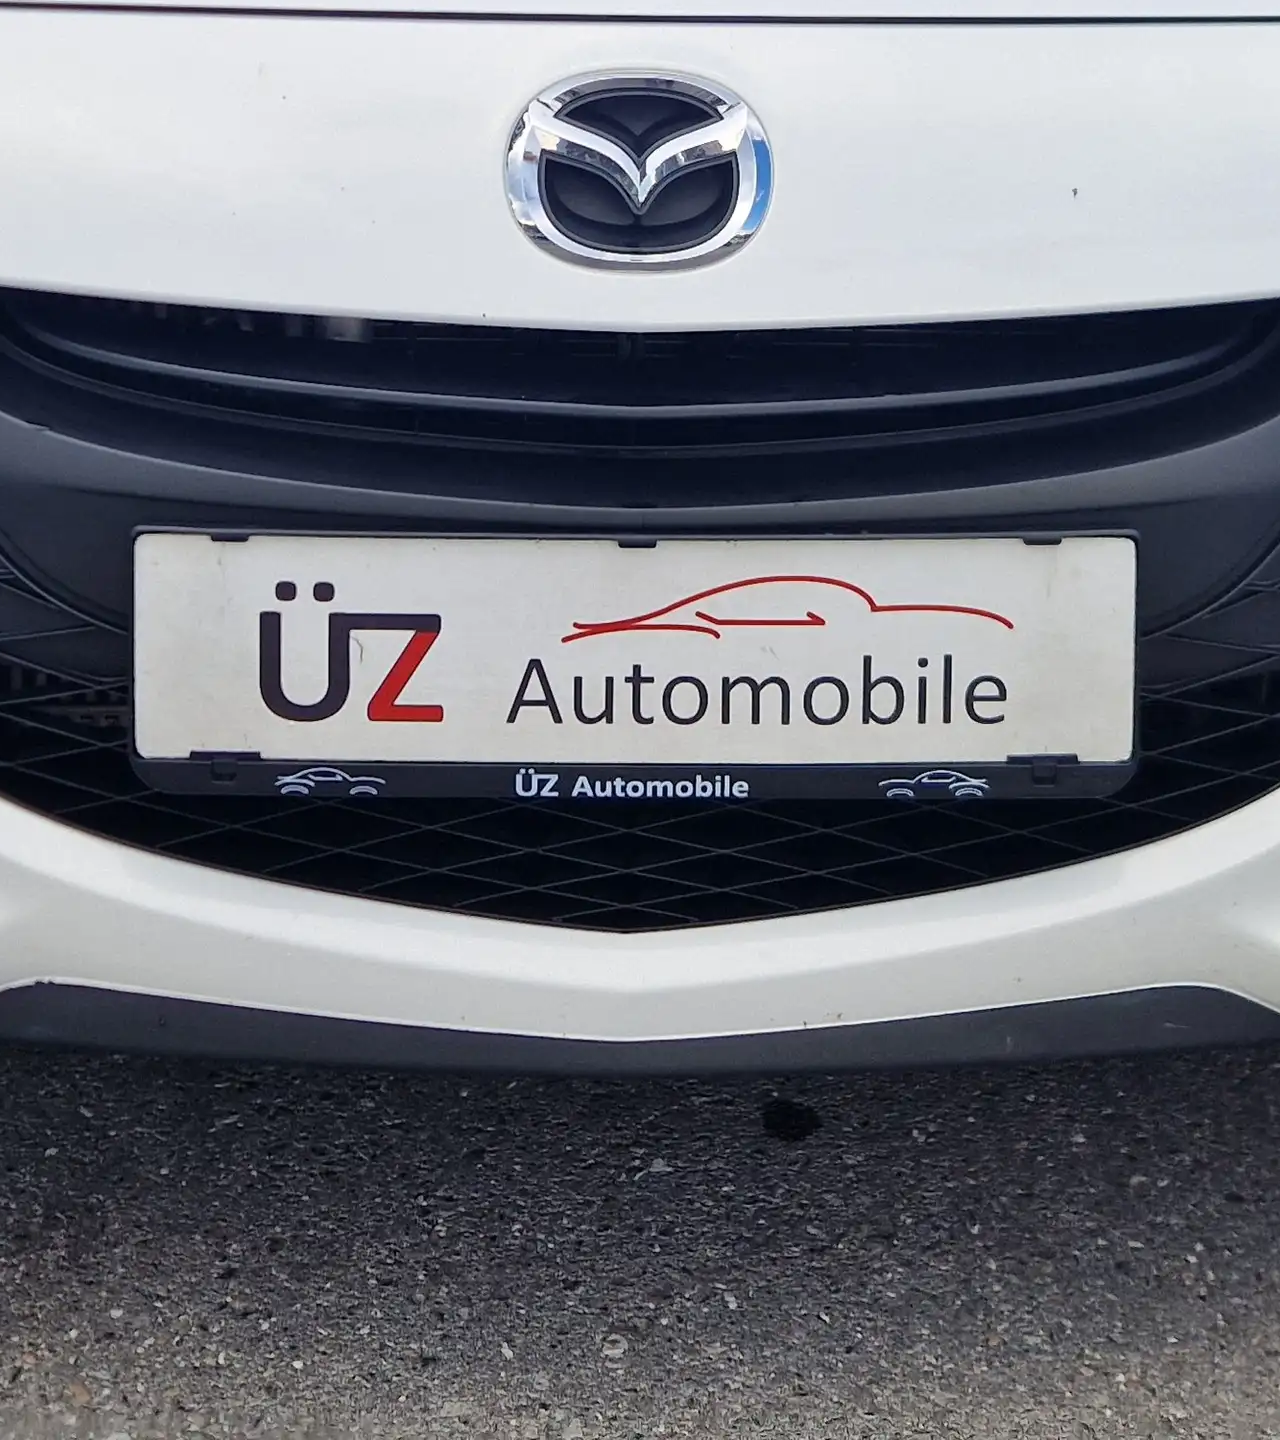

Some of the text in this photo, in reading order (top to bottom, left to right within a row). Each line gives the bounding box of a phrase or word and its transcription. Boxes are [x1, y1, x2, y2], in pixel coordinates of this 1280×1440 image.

[259, 581, 1008, 726] ÜZ Automobile
[515, 768, 749, 798] ÜZ Automobile
